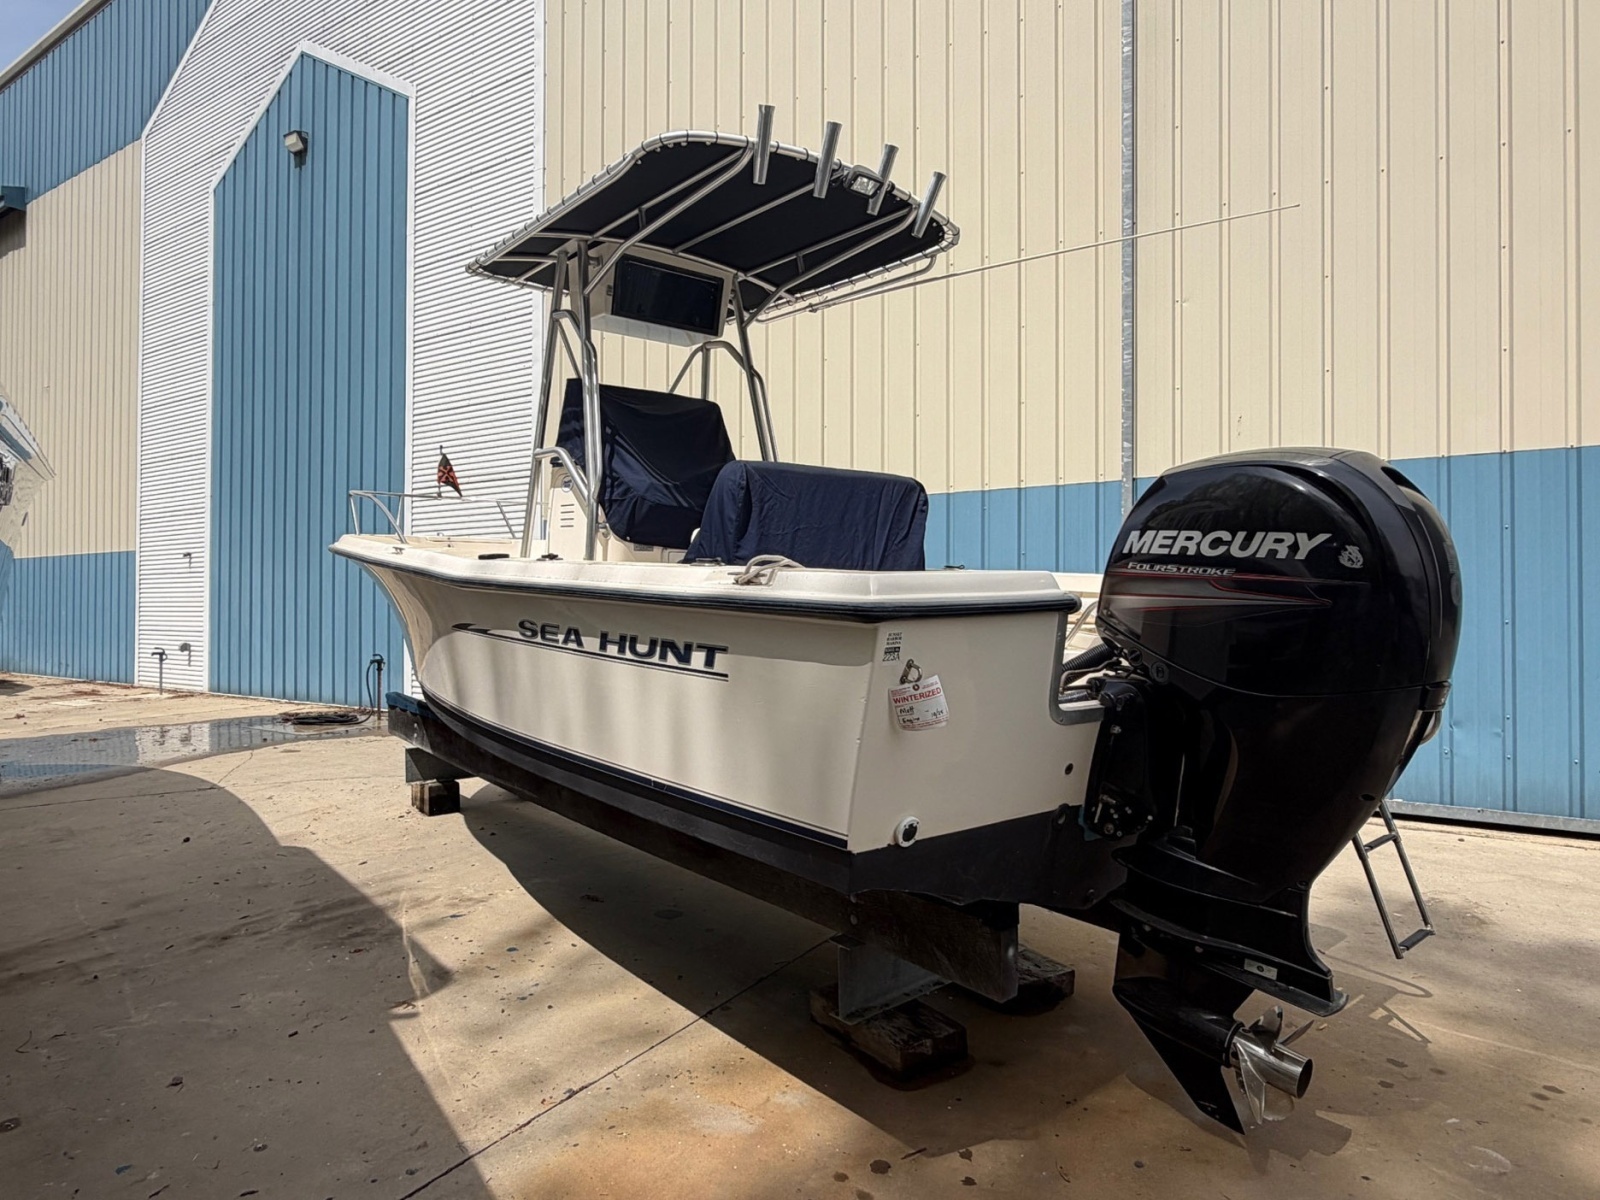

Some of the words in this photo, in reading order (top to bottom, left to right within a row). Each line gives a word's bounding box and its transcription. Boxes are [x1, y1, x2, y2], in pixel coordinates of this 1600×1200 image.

[1122, 529, 1332, 560] MERCURY
[518, 619, 584, 649] SEA
[599, 630, 729, 669] HUNT
[892, 687, 942, 705] WINTERIZED
